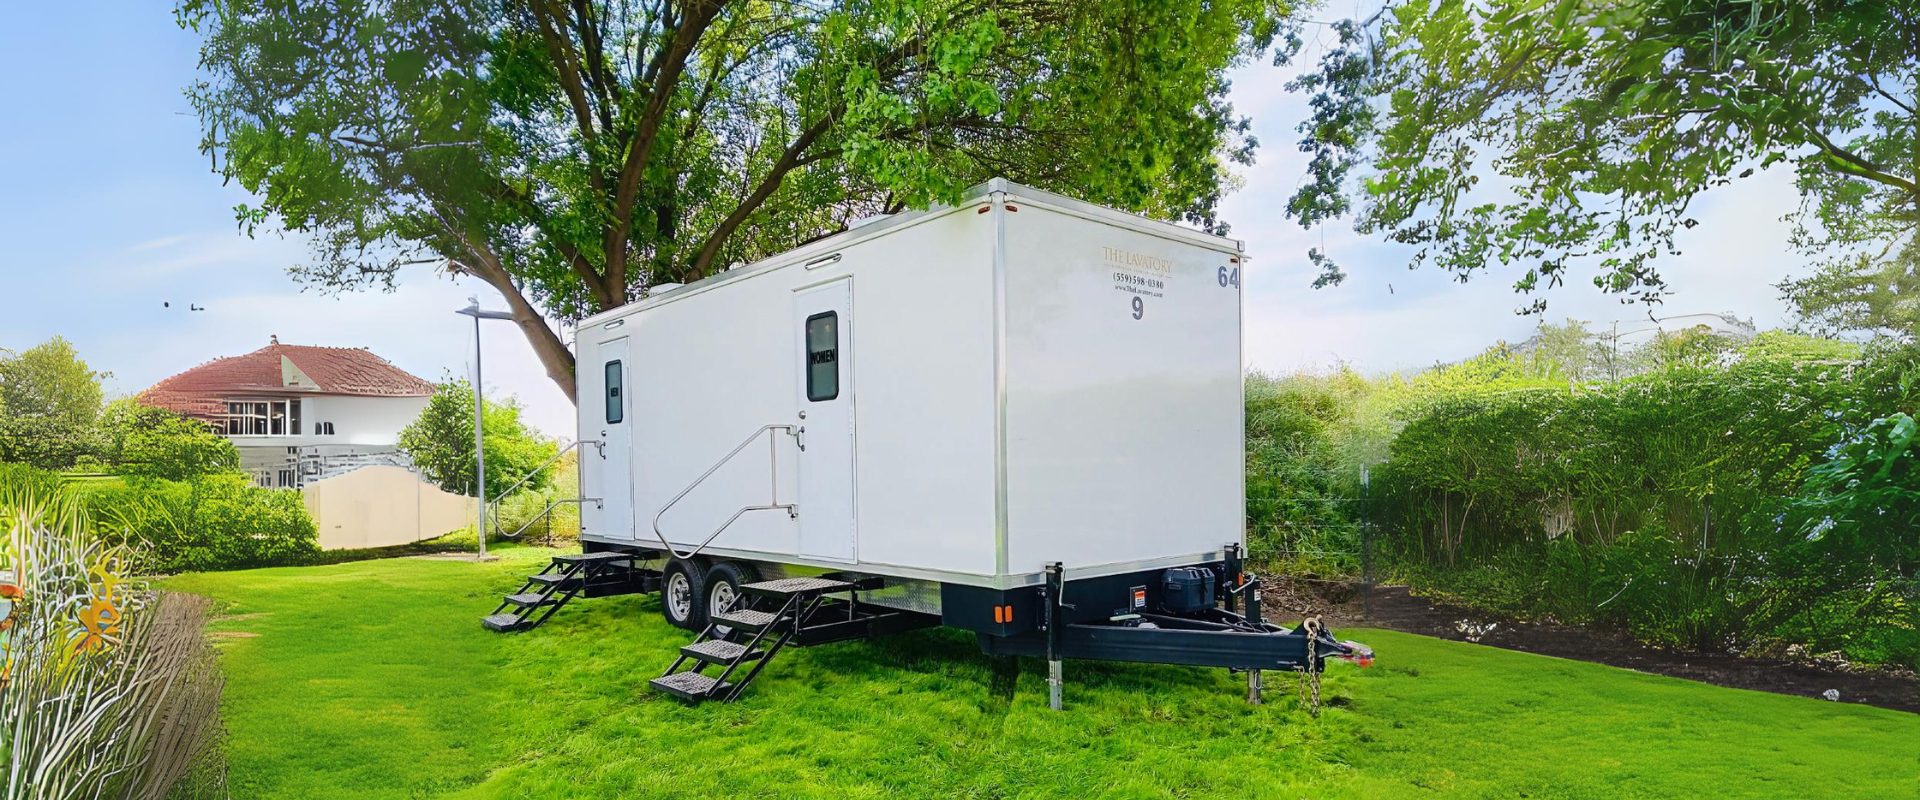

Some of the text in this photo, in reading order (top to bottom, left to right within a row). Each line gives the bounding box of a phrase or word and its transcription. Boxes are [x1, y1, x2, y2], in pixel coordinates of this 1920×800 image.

[1103, 246, 1123, 263] THE
[1126, 251, 1172, 273] LAVATORY
[1217, 265, 1240, 289] 64
[1131, 296, 1144, 320] 9
[810, 348, 835, 365] WOMEN
